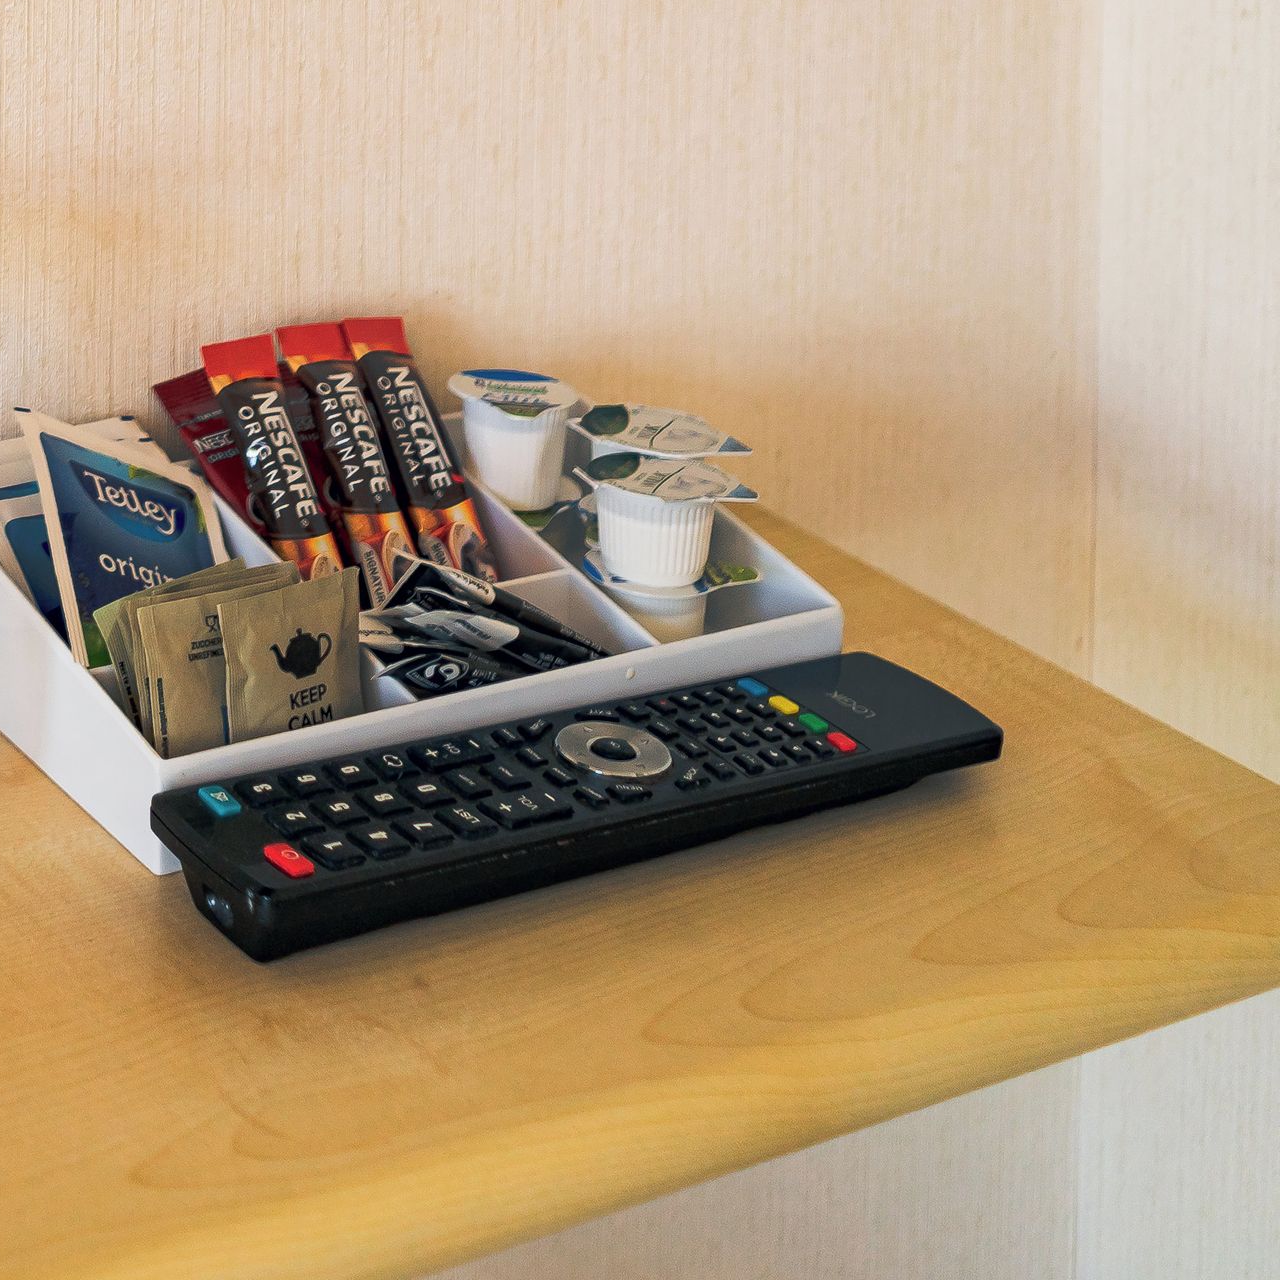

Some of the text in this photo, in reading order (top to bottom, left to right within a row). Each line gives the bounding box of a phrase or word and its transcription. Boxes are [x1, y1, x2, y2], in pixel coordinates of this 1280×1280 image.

[316, 382, 365, 493] ORIGINAL
[377, 376, 426, 487] ORIGINAL
[192, 429, 234, 453] NESC
[238, 405, 290, 519] ORIGINAL
[82, 470, 176, 536] Tetley
[99, 553, 174, 589] origi
[364, 549, 387, 603] SIGNATUR
[289, 683, 327, 710] KEEP
[288, 704, 333, 730] CALM
[340, 765, 360, 775] 9
[297, 774, 317, 784] 6
[252, 783, 273, 793] 3
[417, 784, 437, 793] 0
[373, 793, 394, 803] 8
[518, 794, 538, 811] VOL
[285, 810, 307, 821] 2
[329, 801, 350, 813] 5
[452, 807, 480, 825] LIST
[368, 830, 388, 841] 4
[412, 822, 433, 832] 7
[323, 841, 343, 851] 1
